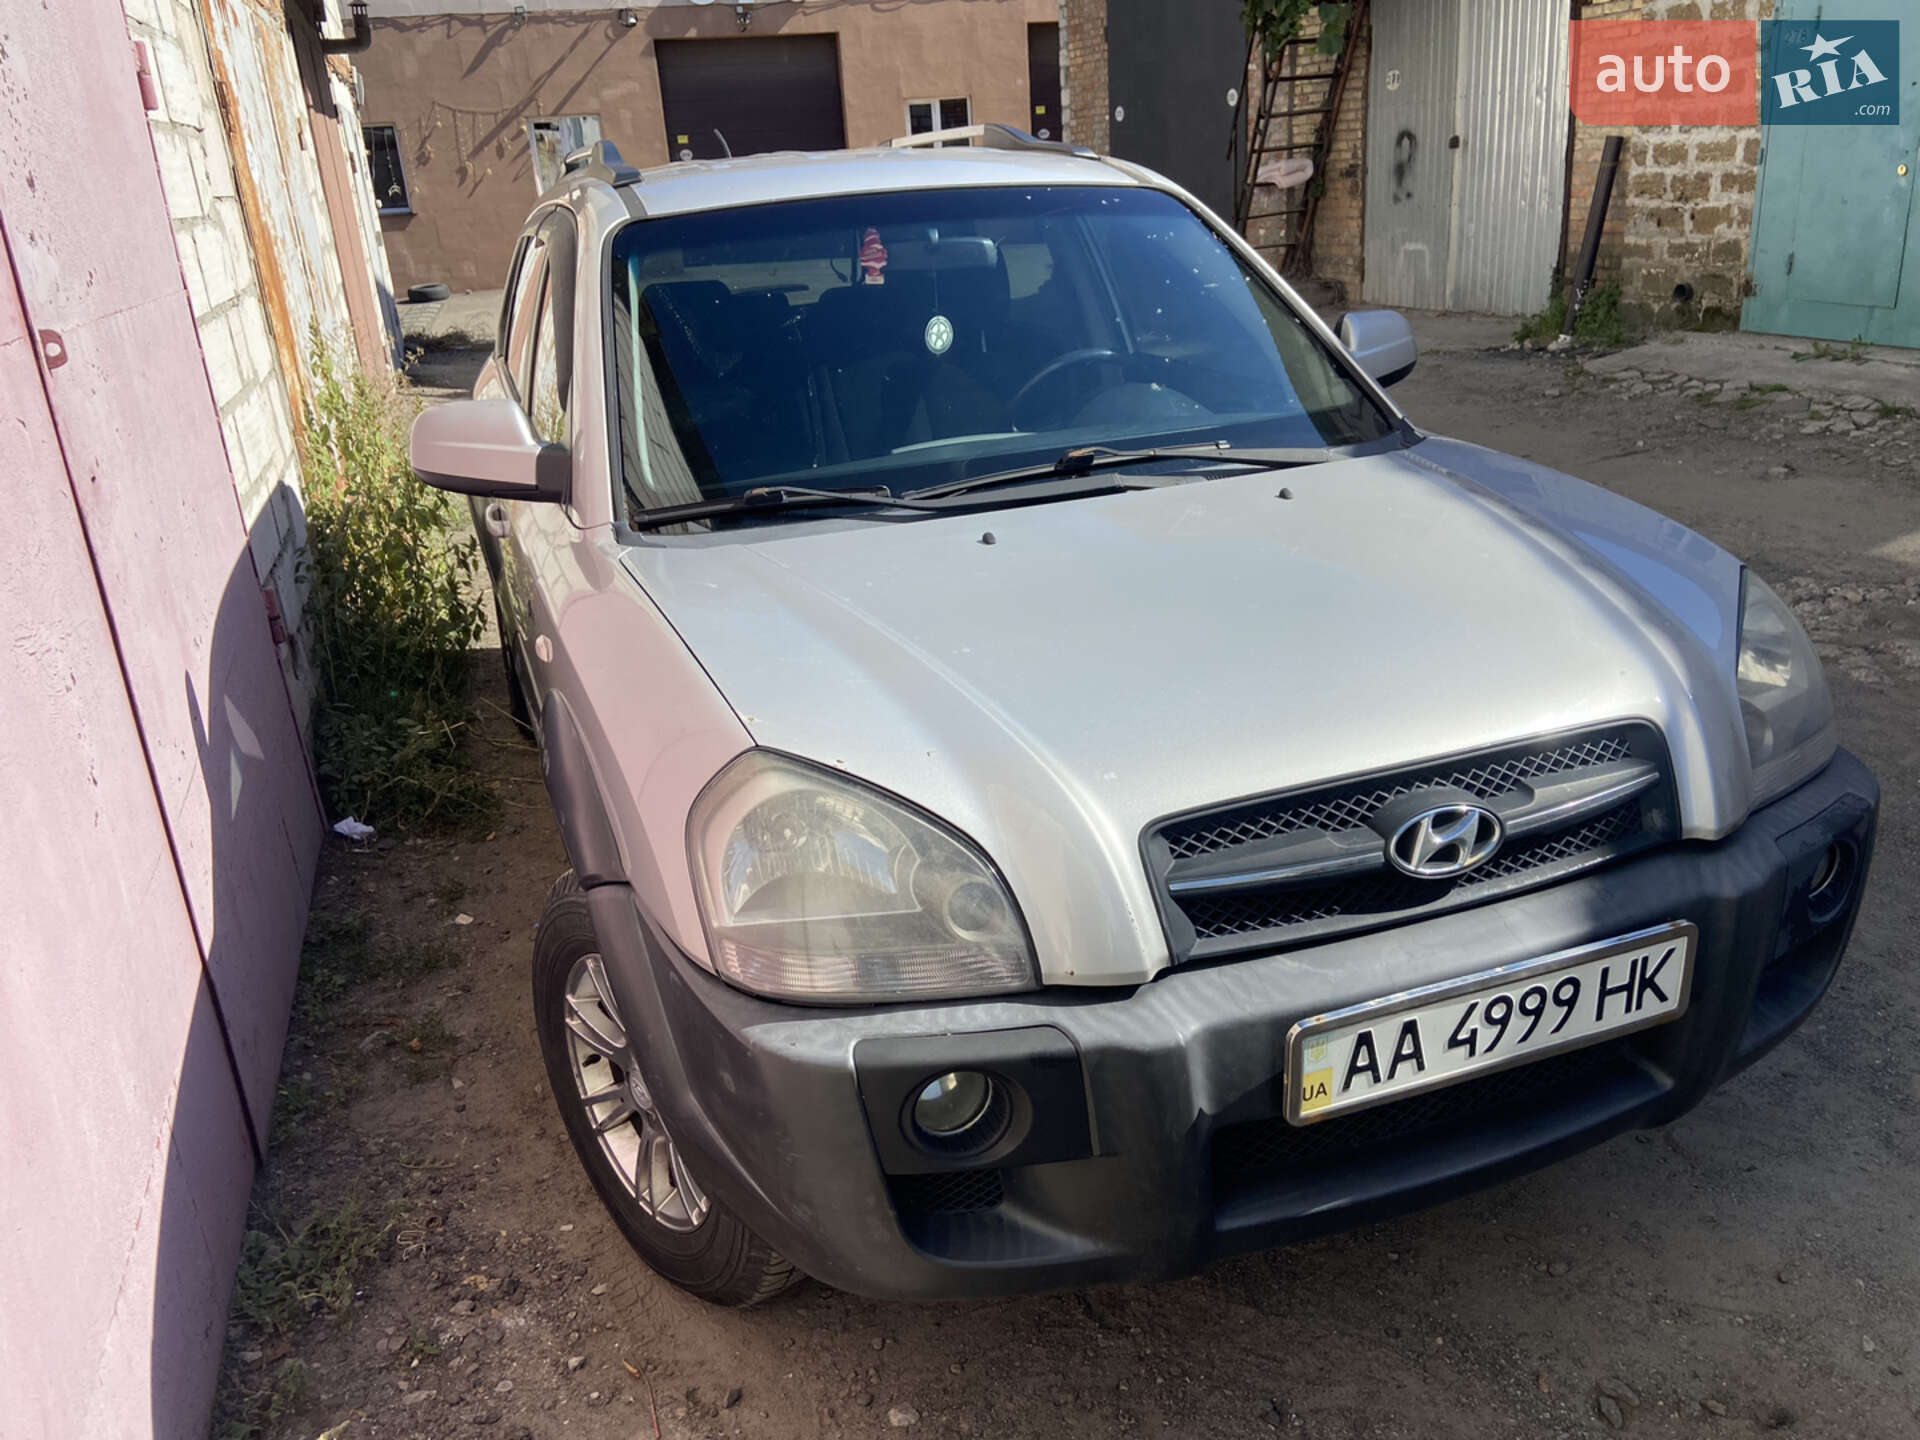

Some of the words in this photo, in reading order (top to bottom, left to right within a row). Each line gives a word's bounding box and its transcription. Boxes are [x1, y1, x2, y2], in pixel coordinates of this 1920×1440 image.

[1341, 1018, 1426, 1092] AA
[1447, 976, 1581, 1058] 4999
[1595, 947, 1677, 1022] HK
[1302, 1082, 1328, 1102] UA
